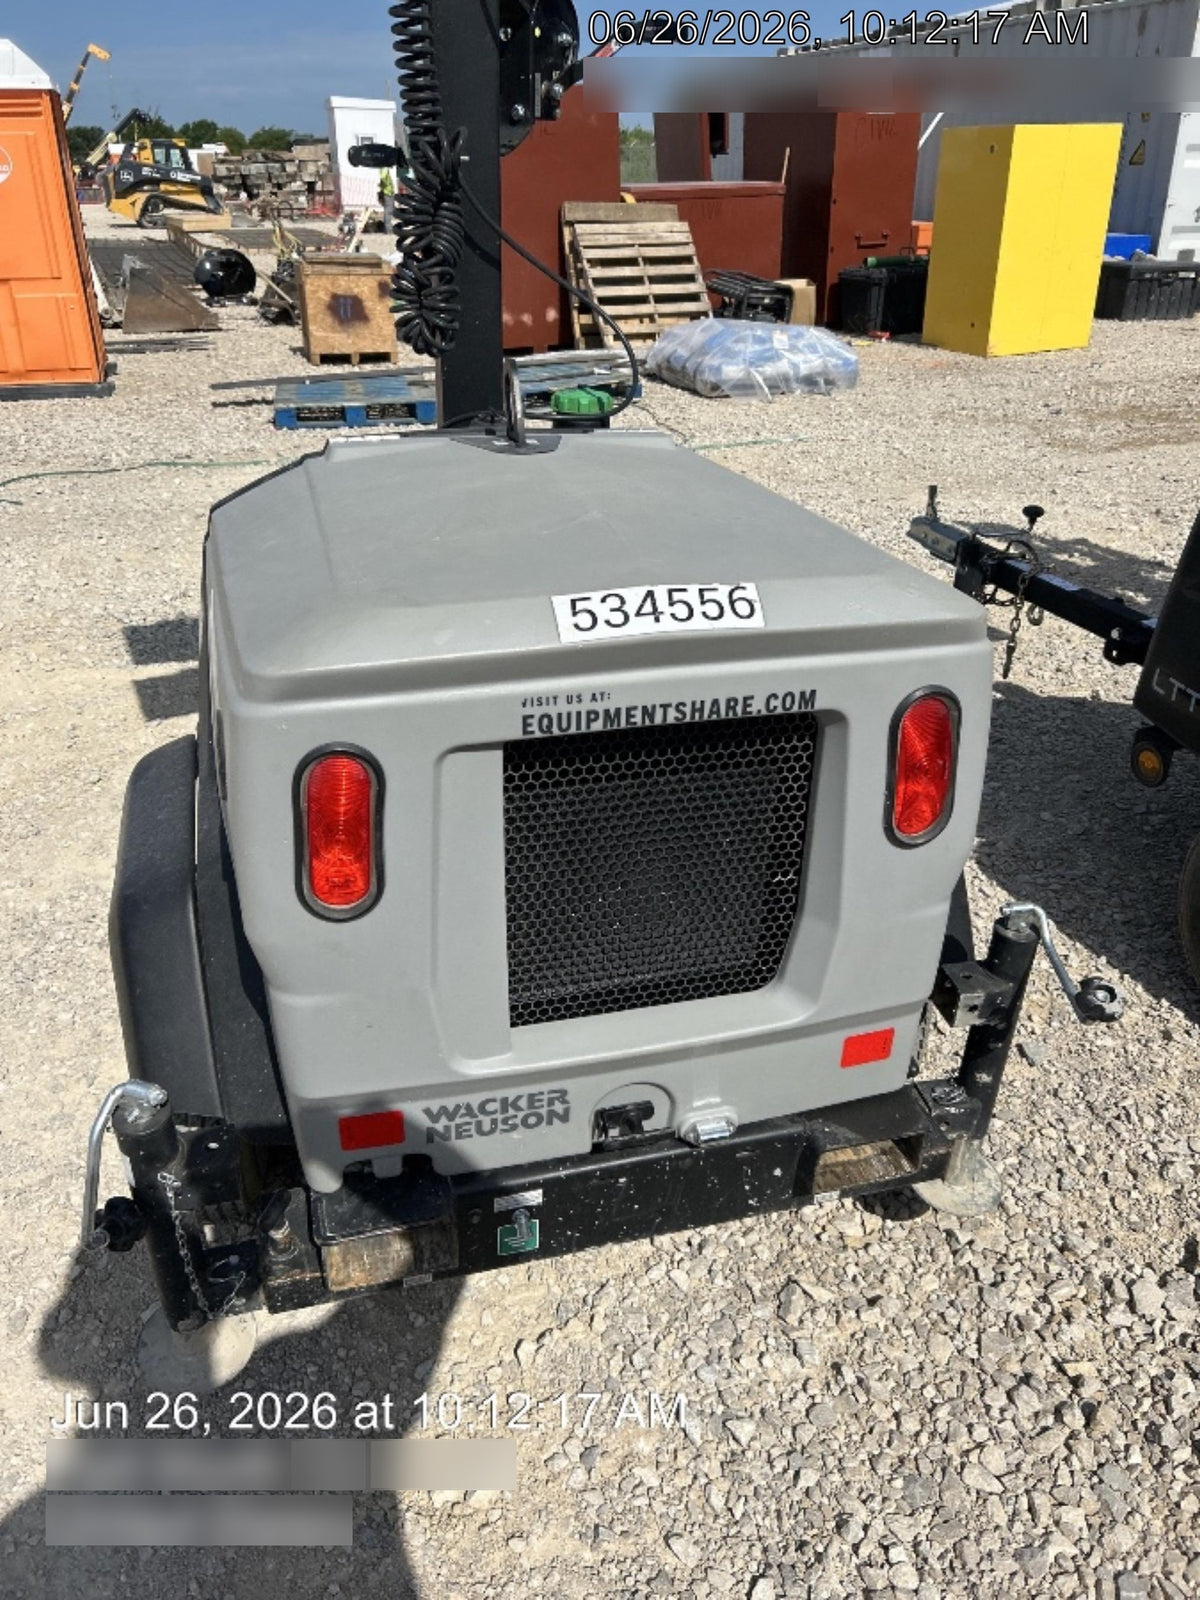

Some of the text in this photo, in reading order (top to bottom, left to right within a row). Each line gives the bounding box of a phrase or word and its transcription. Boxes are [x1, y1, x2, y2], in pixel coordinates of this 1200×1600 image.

[569, 586, 756, 632] 534556
[521, 691, 611, 708] VISIT US AT:
[521, 689, 817, 736] EQUIPMENTSHARE.COM
[421, 1088, 570, 1125] WACKER
[425, 1106, 571, 1144] NEUSON
